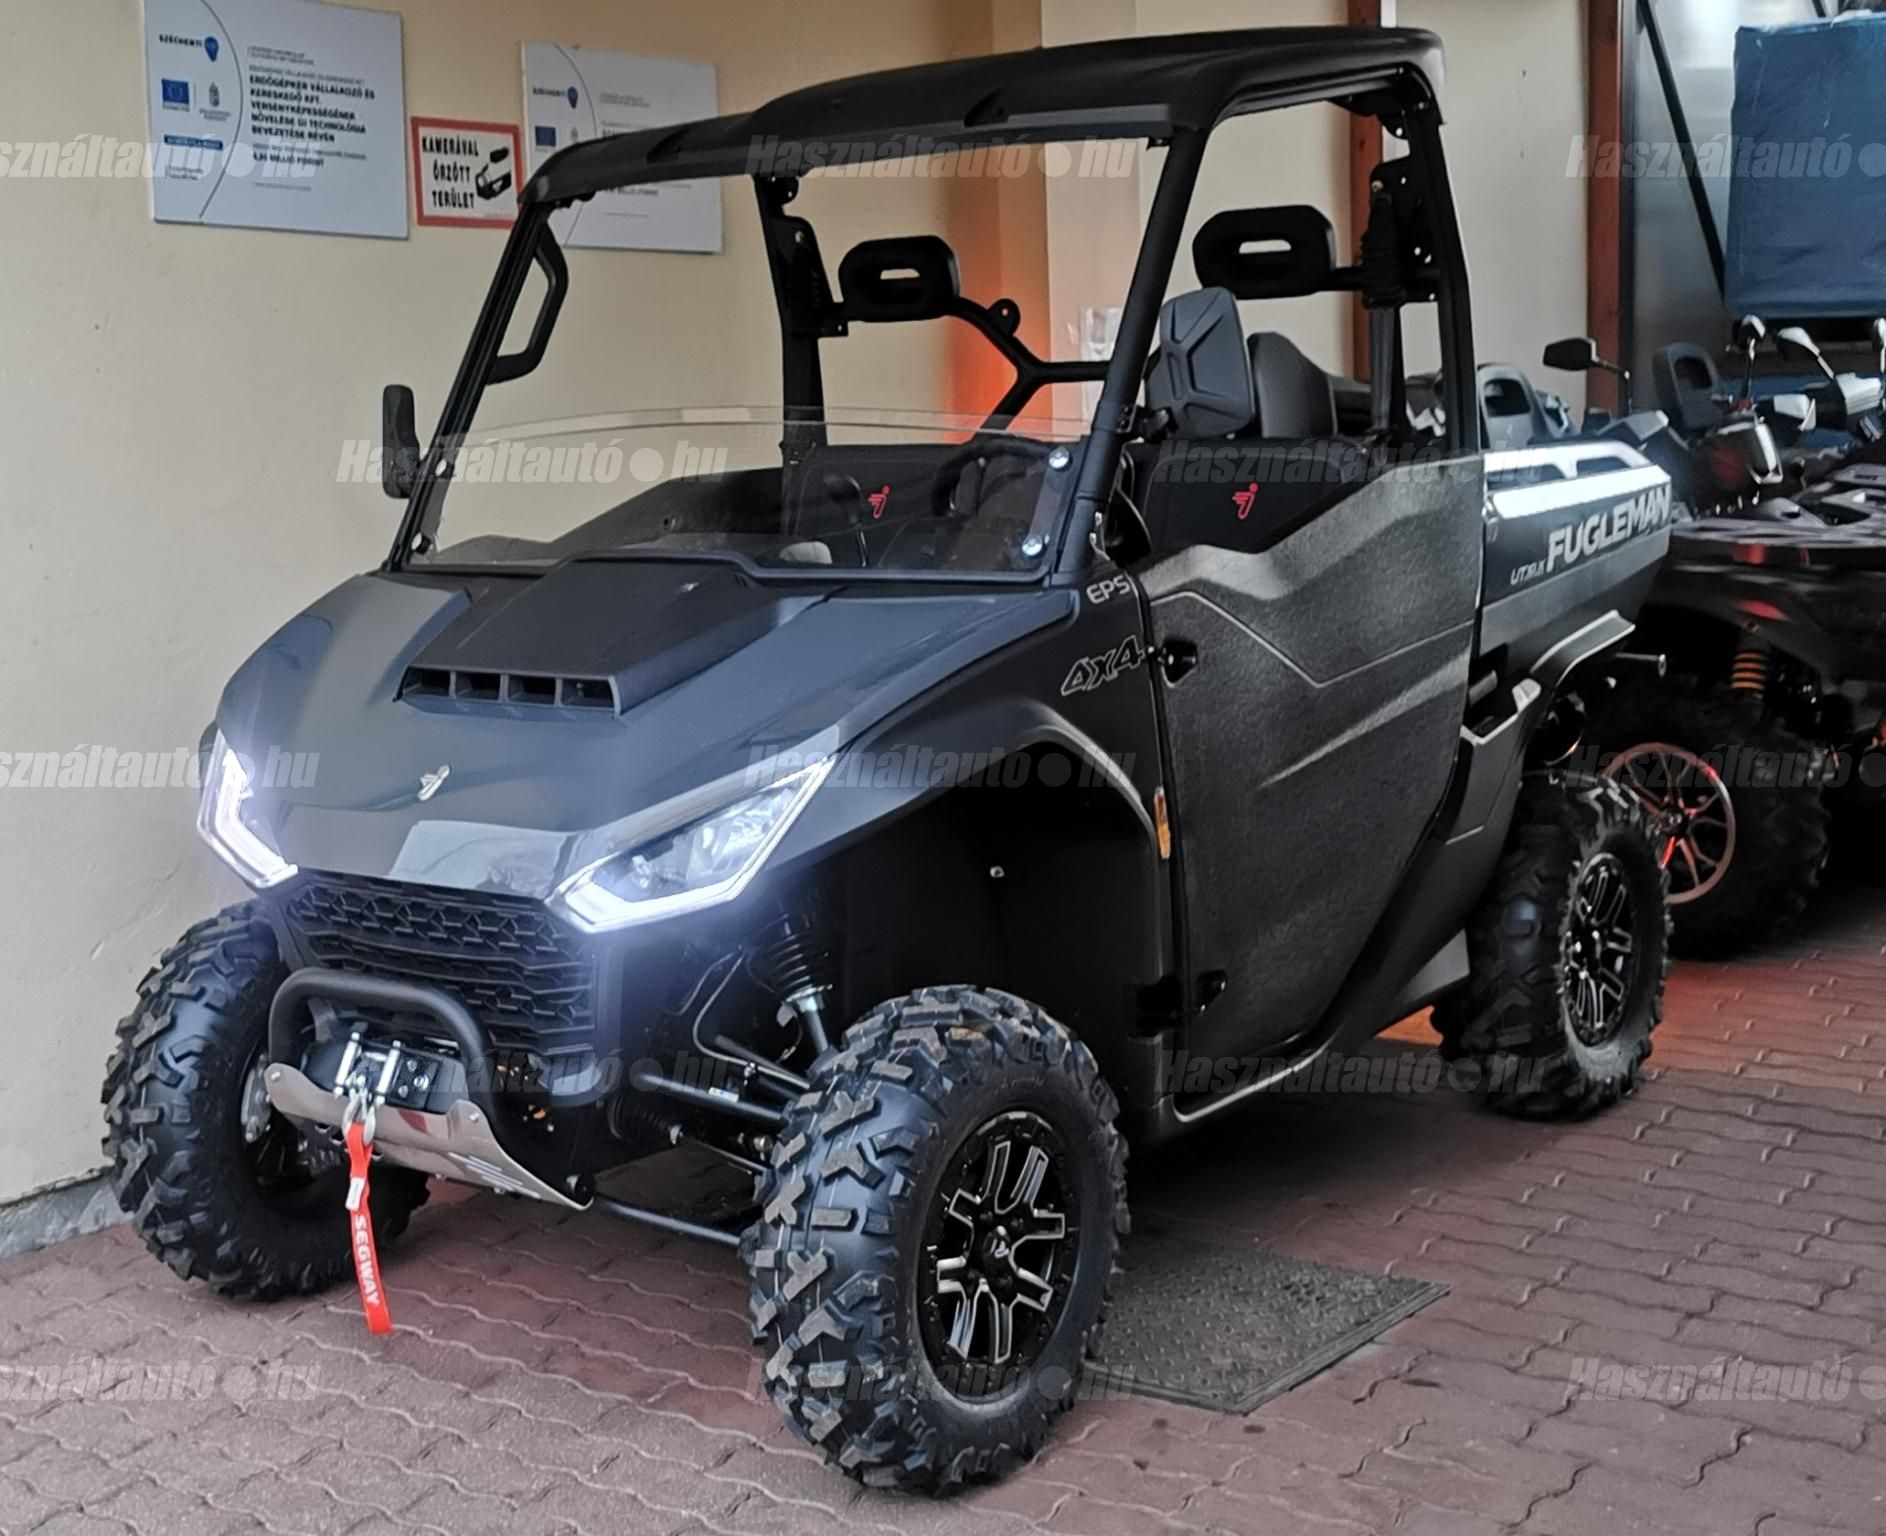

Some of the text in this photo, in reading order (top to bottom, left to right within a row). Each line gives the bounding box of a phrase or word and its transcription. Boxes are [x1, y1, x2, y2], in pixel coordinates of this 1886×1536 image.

[422, 134, 479, 157] KAMERÁVAL
[432, 187, 474, 209] TERÜLET
[1546, 481, 1672, 573] FUGLEMAN
[1087, 574, 1131, 604] EPS
[1061, 634, 1146, 696] 4X4
[354, 1213, 381, 1306] SEGWAY
